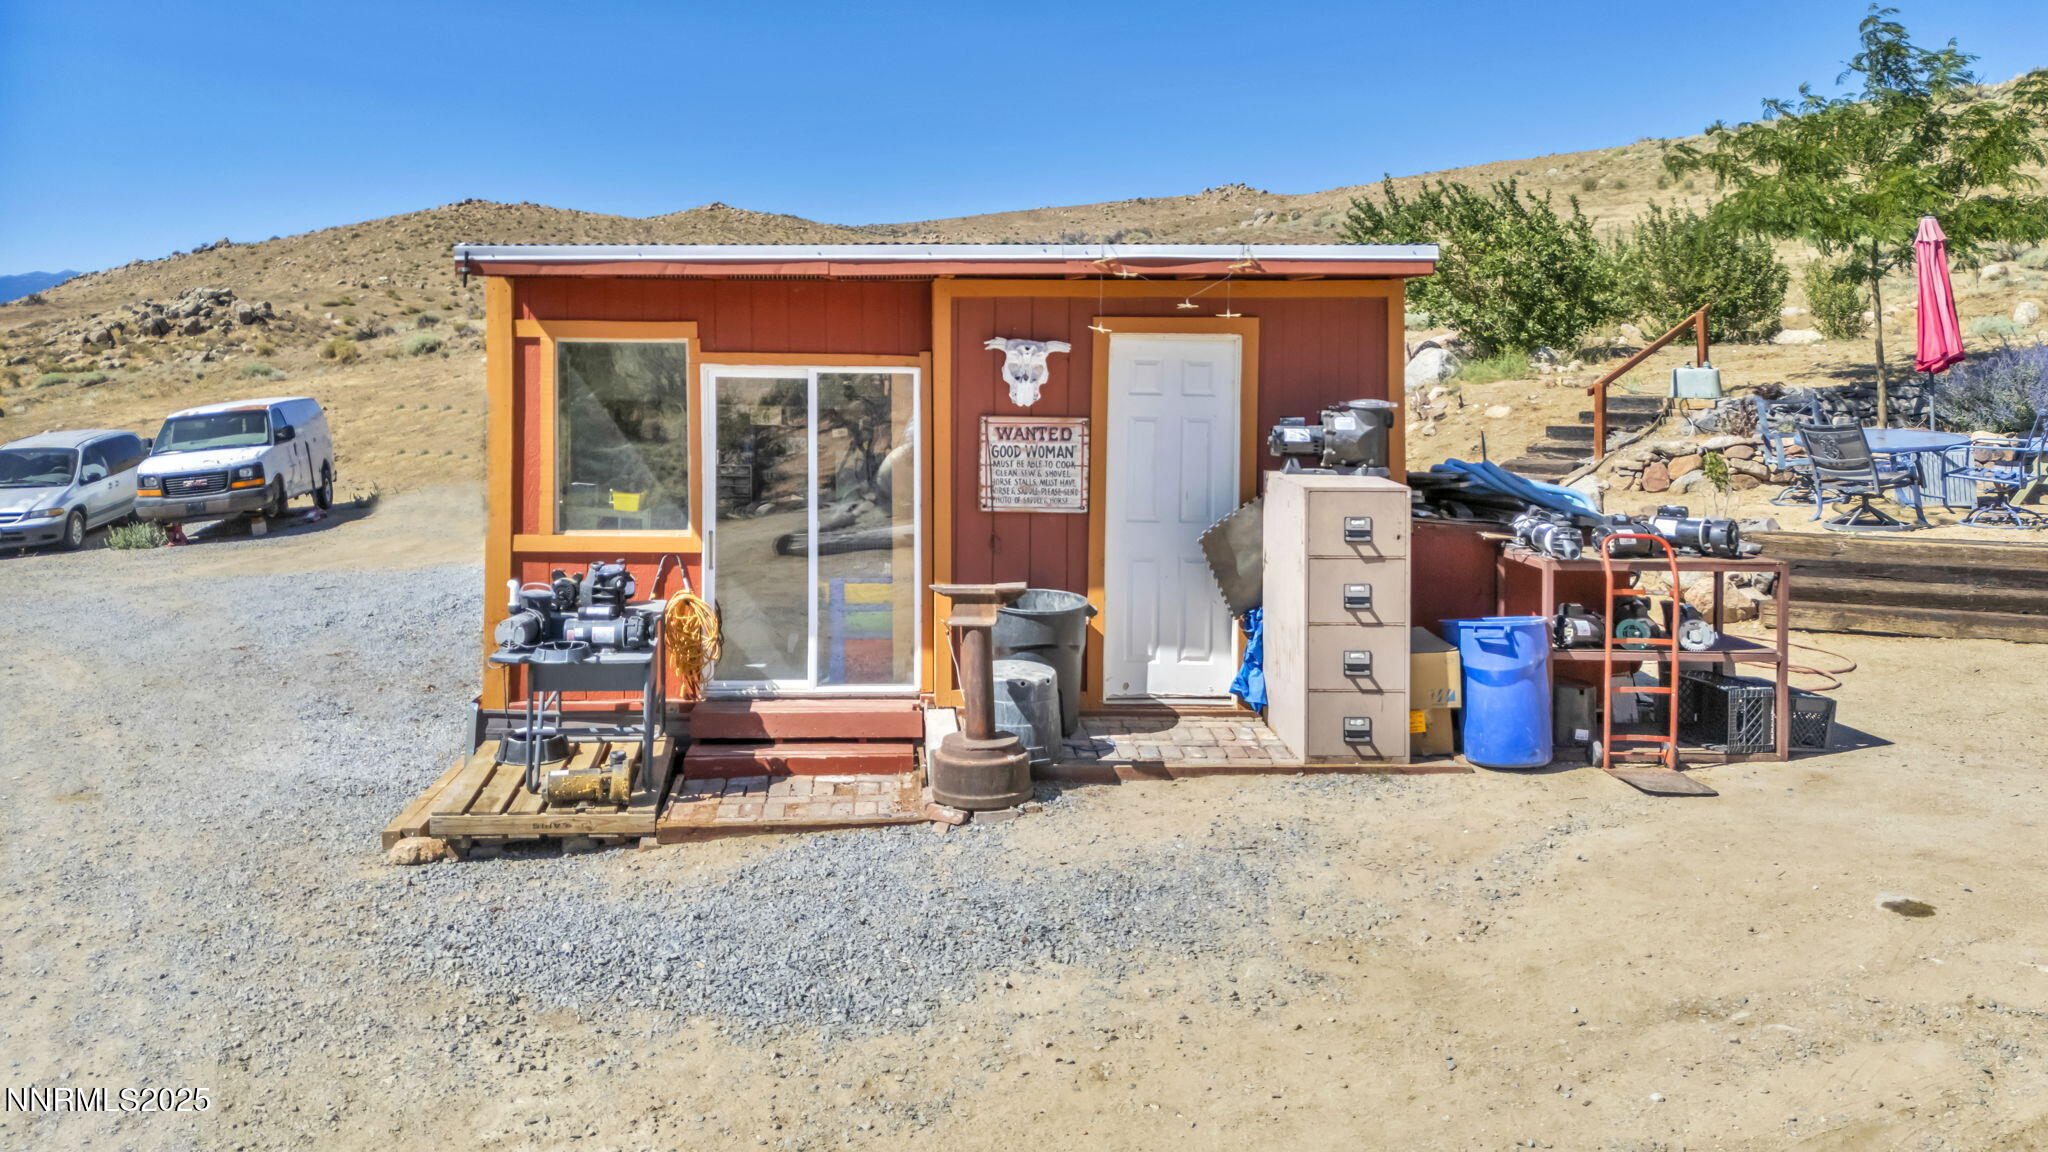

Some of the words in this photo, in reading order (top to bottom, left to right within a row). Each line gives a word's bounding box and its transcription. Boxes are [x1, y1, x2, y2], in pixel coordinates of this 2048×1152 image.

[995, 426, 1072, 441] WANTED
[992, 460, 1013, 468] MUST
[1016, 460, 1025, 468] BE
[1027, 460, 1041, 468] ABLE
[1044, 460, 1053, 469] TO
[995, 469, 1018, 477] CLEAN
[1021, 469, 1036, 477] SEW
[1039, 478, 1057, 486] MUST
